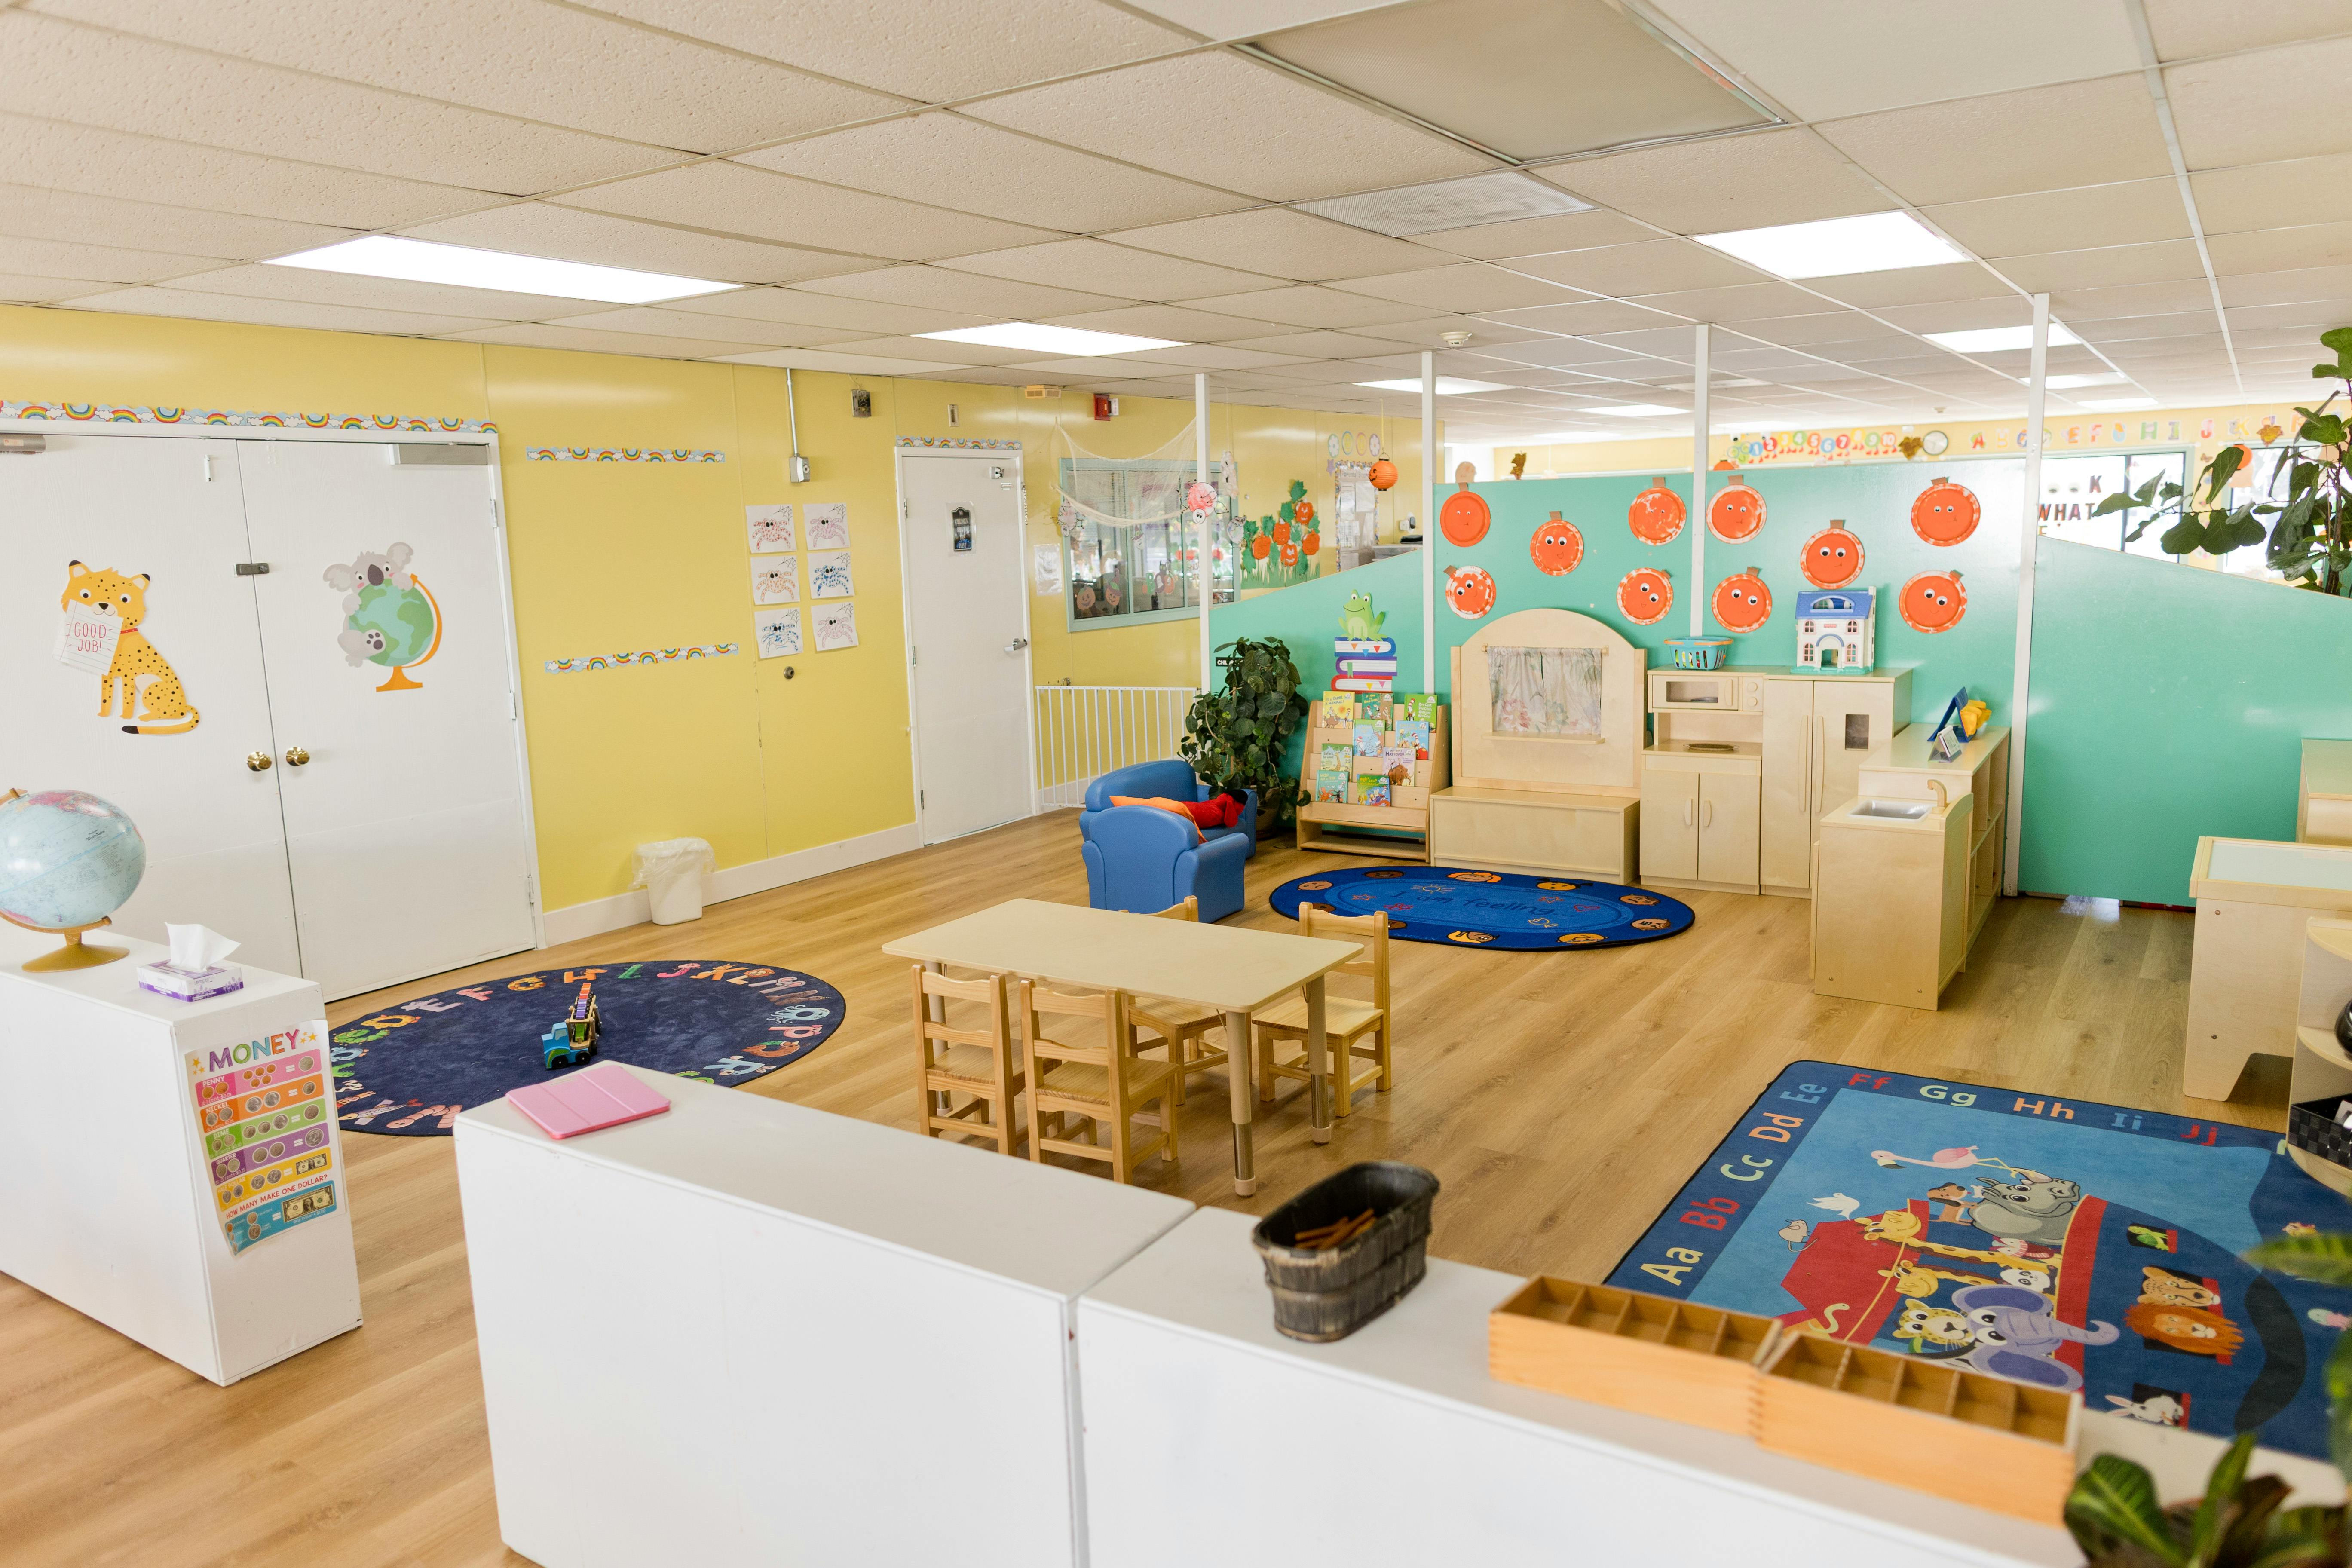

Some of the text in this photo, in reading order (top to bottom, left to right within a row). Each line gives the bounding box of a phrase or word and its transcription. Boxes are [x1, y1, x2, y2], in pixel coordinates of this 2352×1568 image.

[2140, 421, 2157, 440] H
[2200, 420, 2213, 439] J
[1883, 435, 1894, 445] 10
[2039, 503, 2095, 521] WHAT
[74, 622, 106, 638] GOOD
[77, 639, 102, 652] JOB!
[1390, 891, 1410, 899] I
[209, 1029, 300, 1072] MONEY
[202, 1075, 225, 1087] PENNY
[206, 1101, 229, 1114] NICKEL
[1848, 1073, 2219, 1146] Ff Gg Hh Ii Jj
[213, 1128, 230, 1139] DIME
[216, 1153, 236, 1165] QUARTER
[1640, 1083, 1828, 1286] Aa Bb Cc Dd Ee
[226, 1209, 238, 1219] HOW
[239, 1199, 258, 1212] MANY
[260, 1191, 280, 1203] MAKE
[282, 1185, 296, 1195] ONE
[297, 1174, 328, 1189] DOLLAR?
